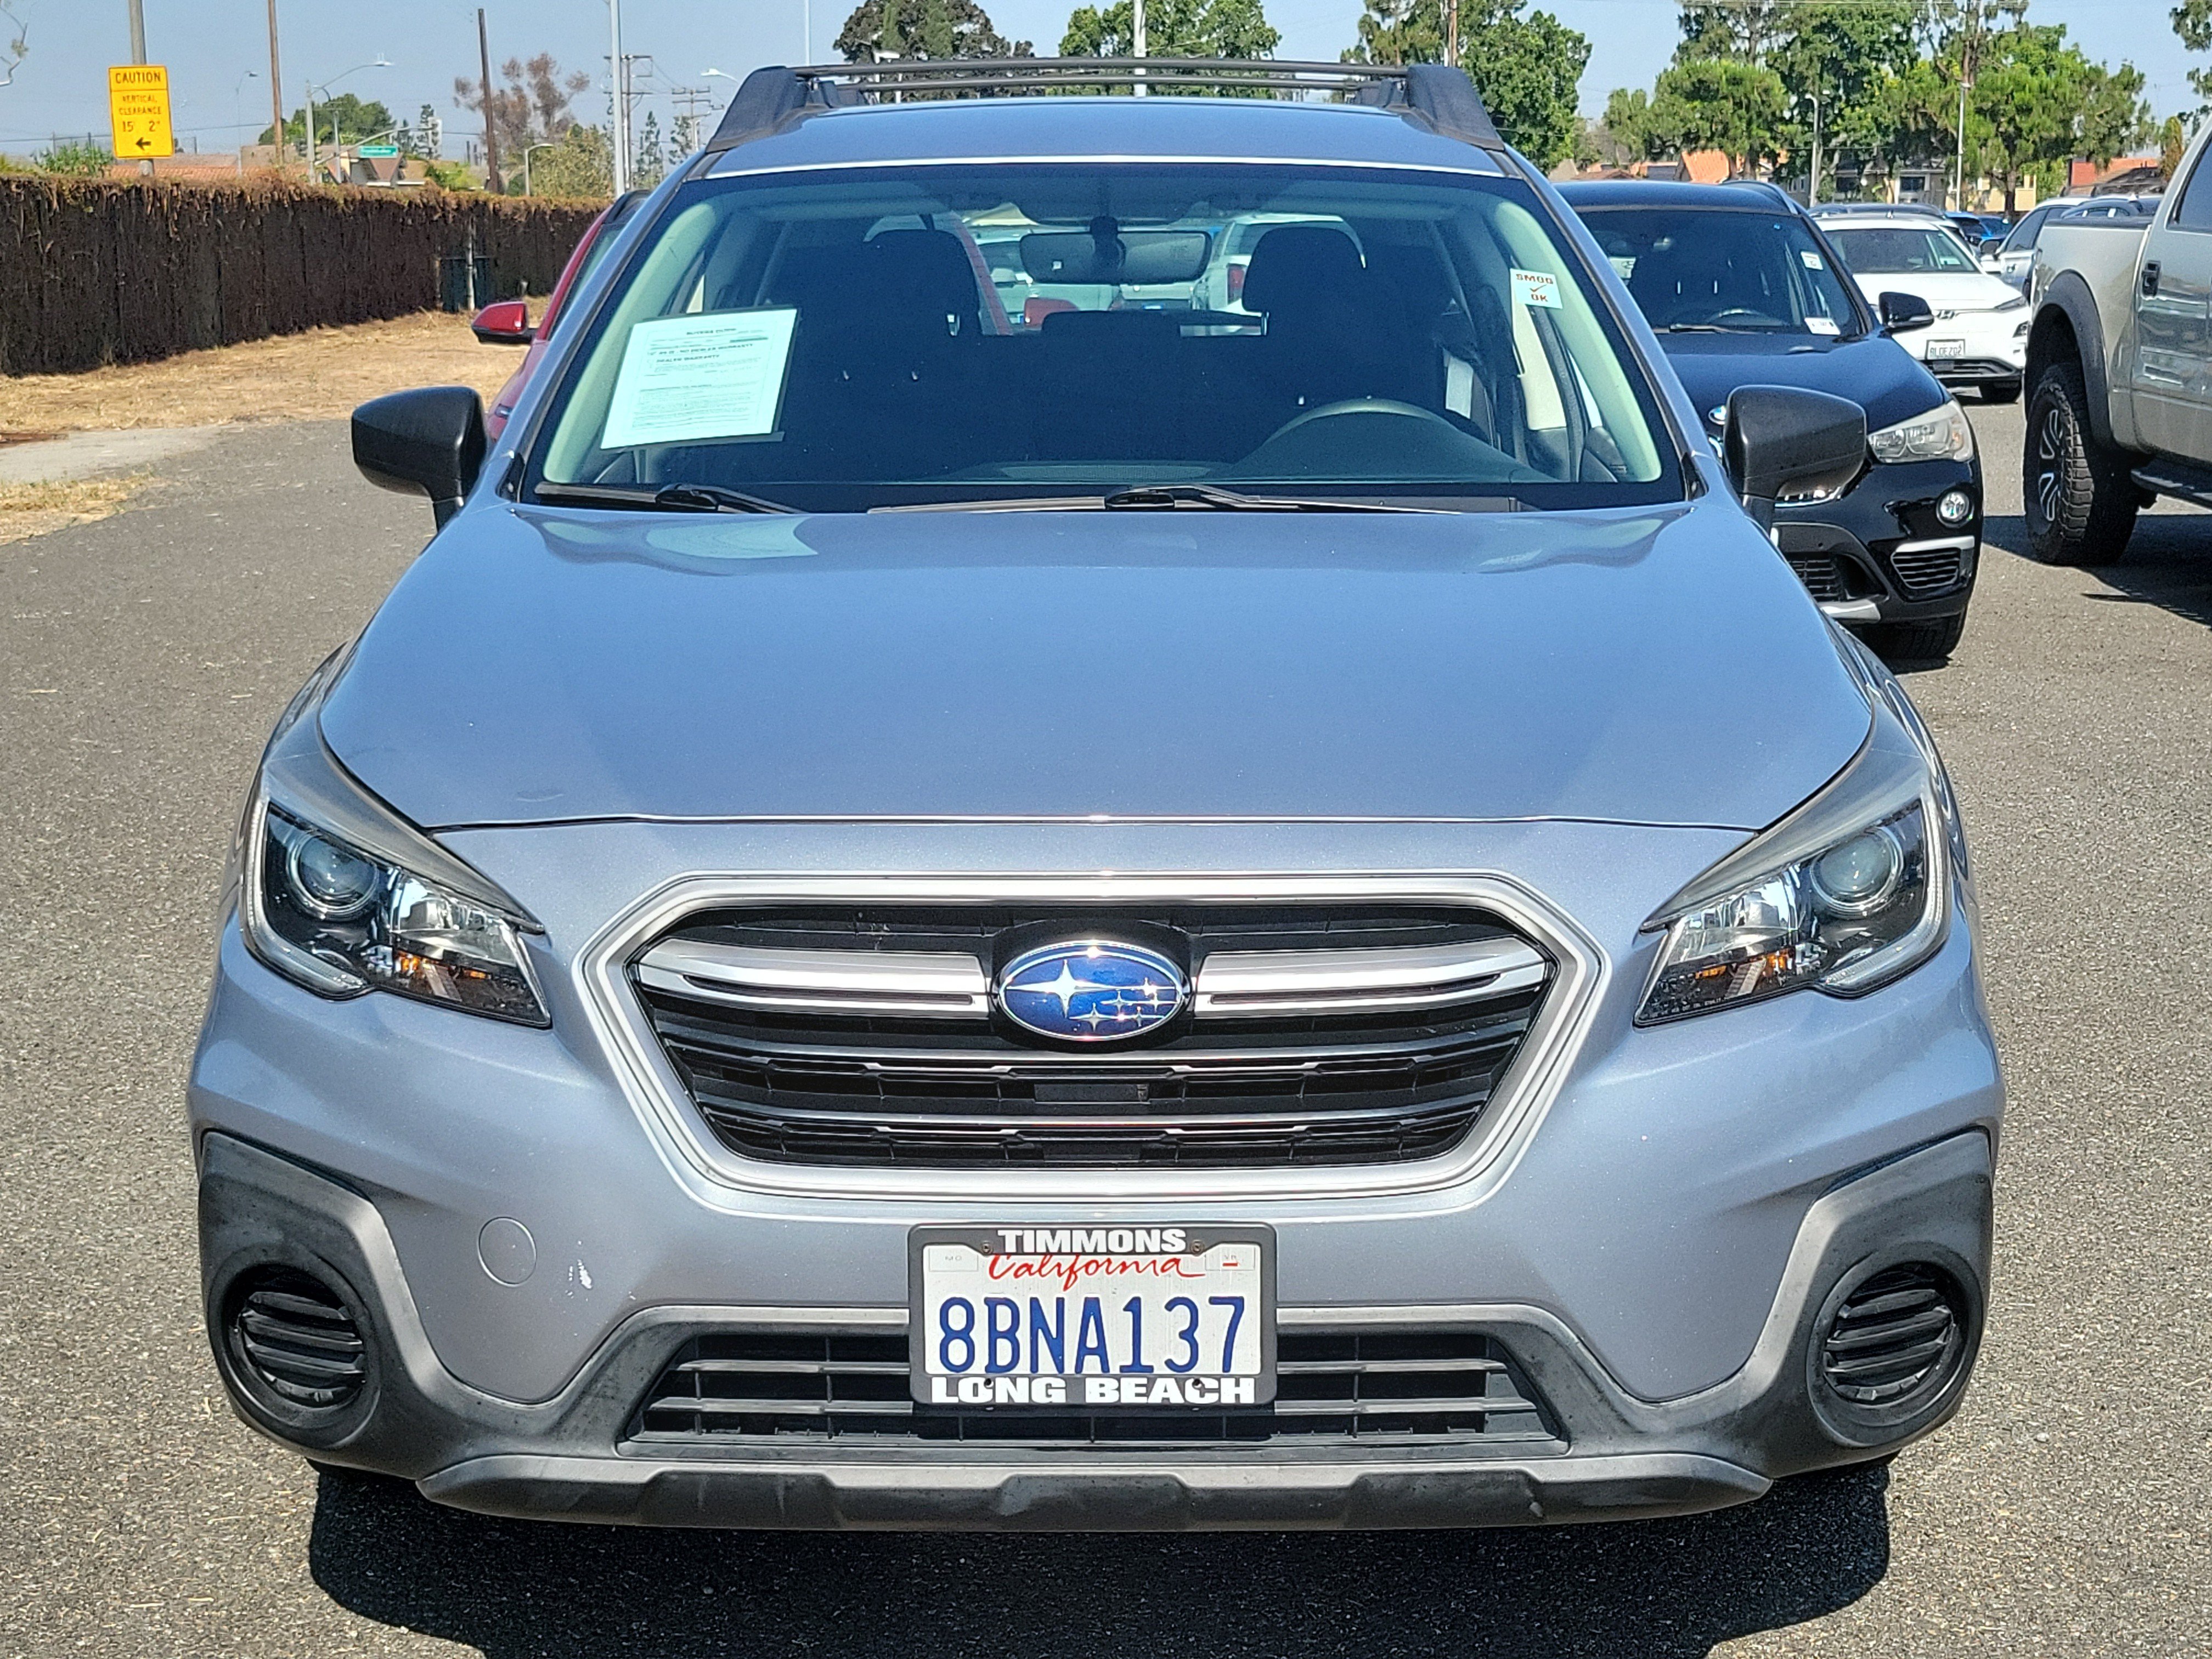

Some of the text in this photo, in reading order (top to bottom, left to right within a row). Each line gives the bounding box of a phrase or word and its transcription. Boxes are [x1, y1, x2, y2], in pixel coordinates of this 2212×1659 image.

[115, 72, 161, 84] CAUTION
[1516, 274, 1553, 284] SMOG
[998, 1229, 1186, 1253] TIMMONS
[989, 1254, 1206, 1291] California
[939, 1296, 1244, 1373] 8BNA137
[932, 1376, 1254, 1403] LONG BEACH
